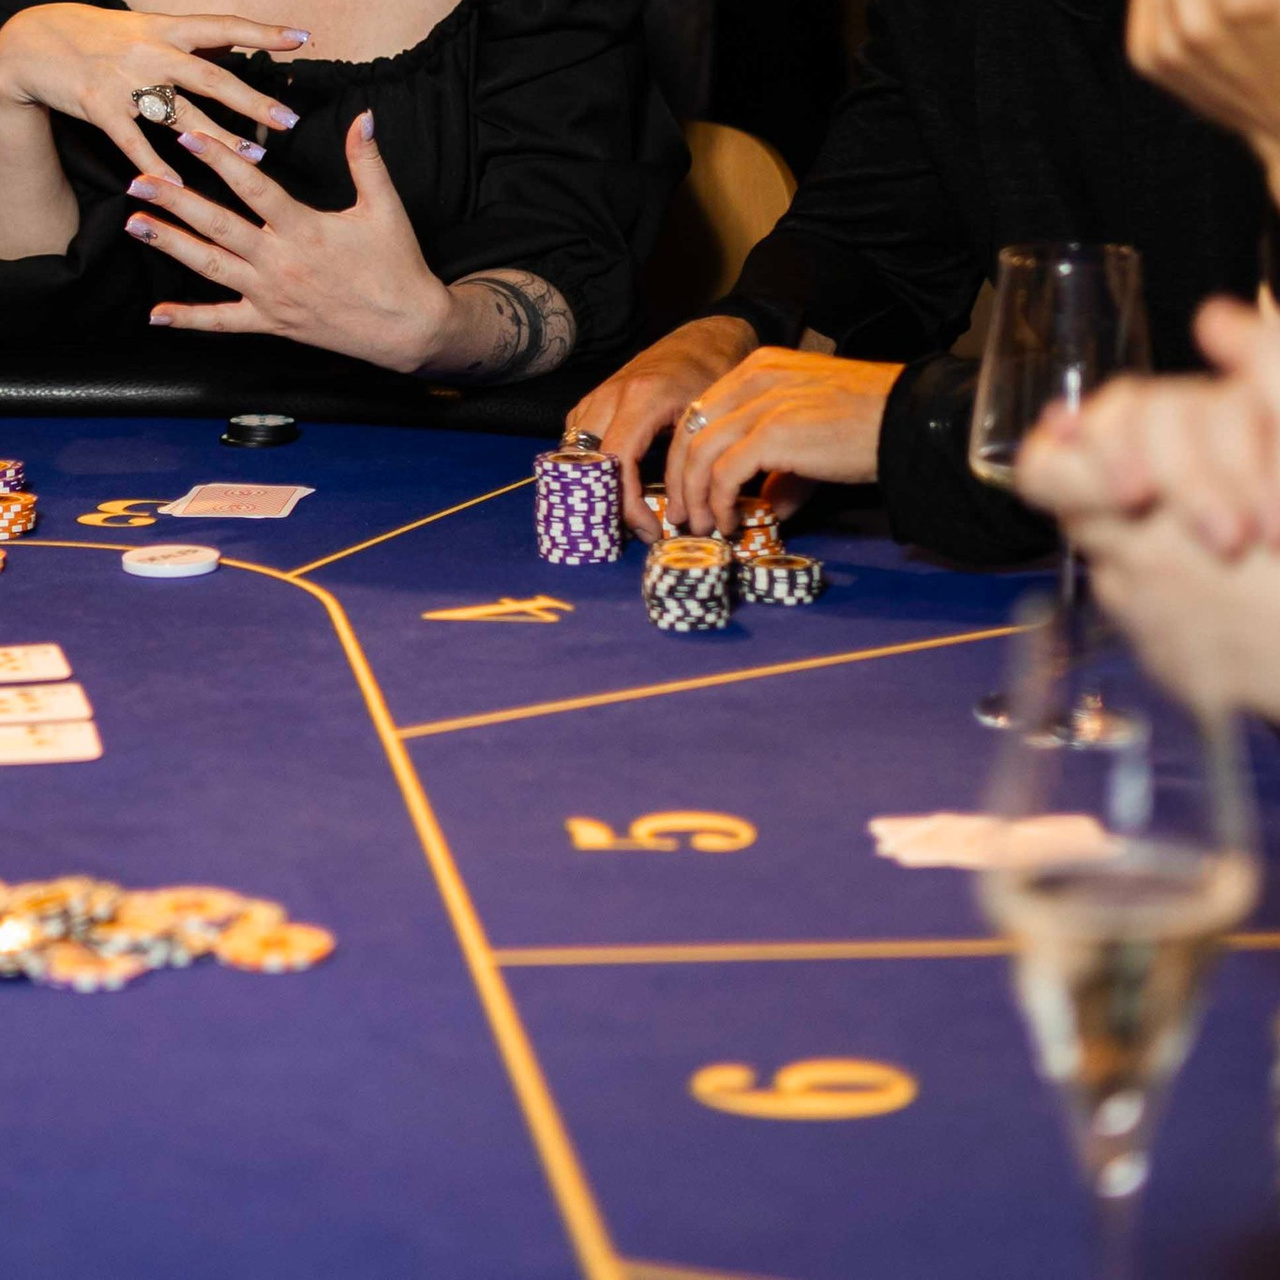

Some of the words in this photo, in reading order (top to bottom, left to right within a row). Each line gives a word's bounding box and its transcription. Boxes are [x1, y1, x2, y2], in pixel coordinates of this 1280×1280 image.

[76, 500, 172, 527] 3
[421, 594, 574, 622] 4
[566, 811, 757, 852] 5
[691, 1057, 917, 1120] 6
